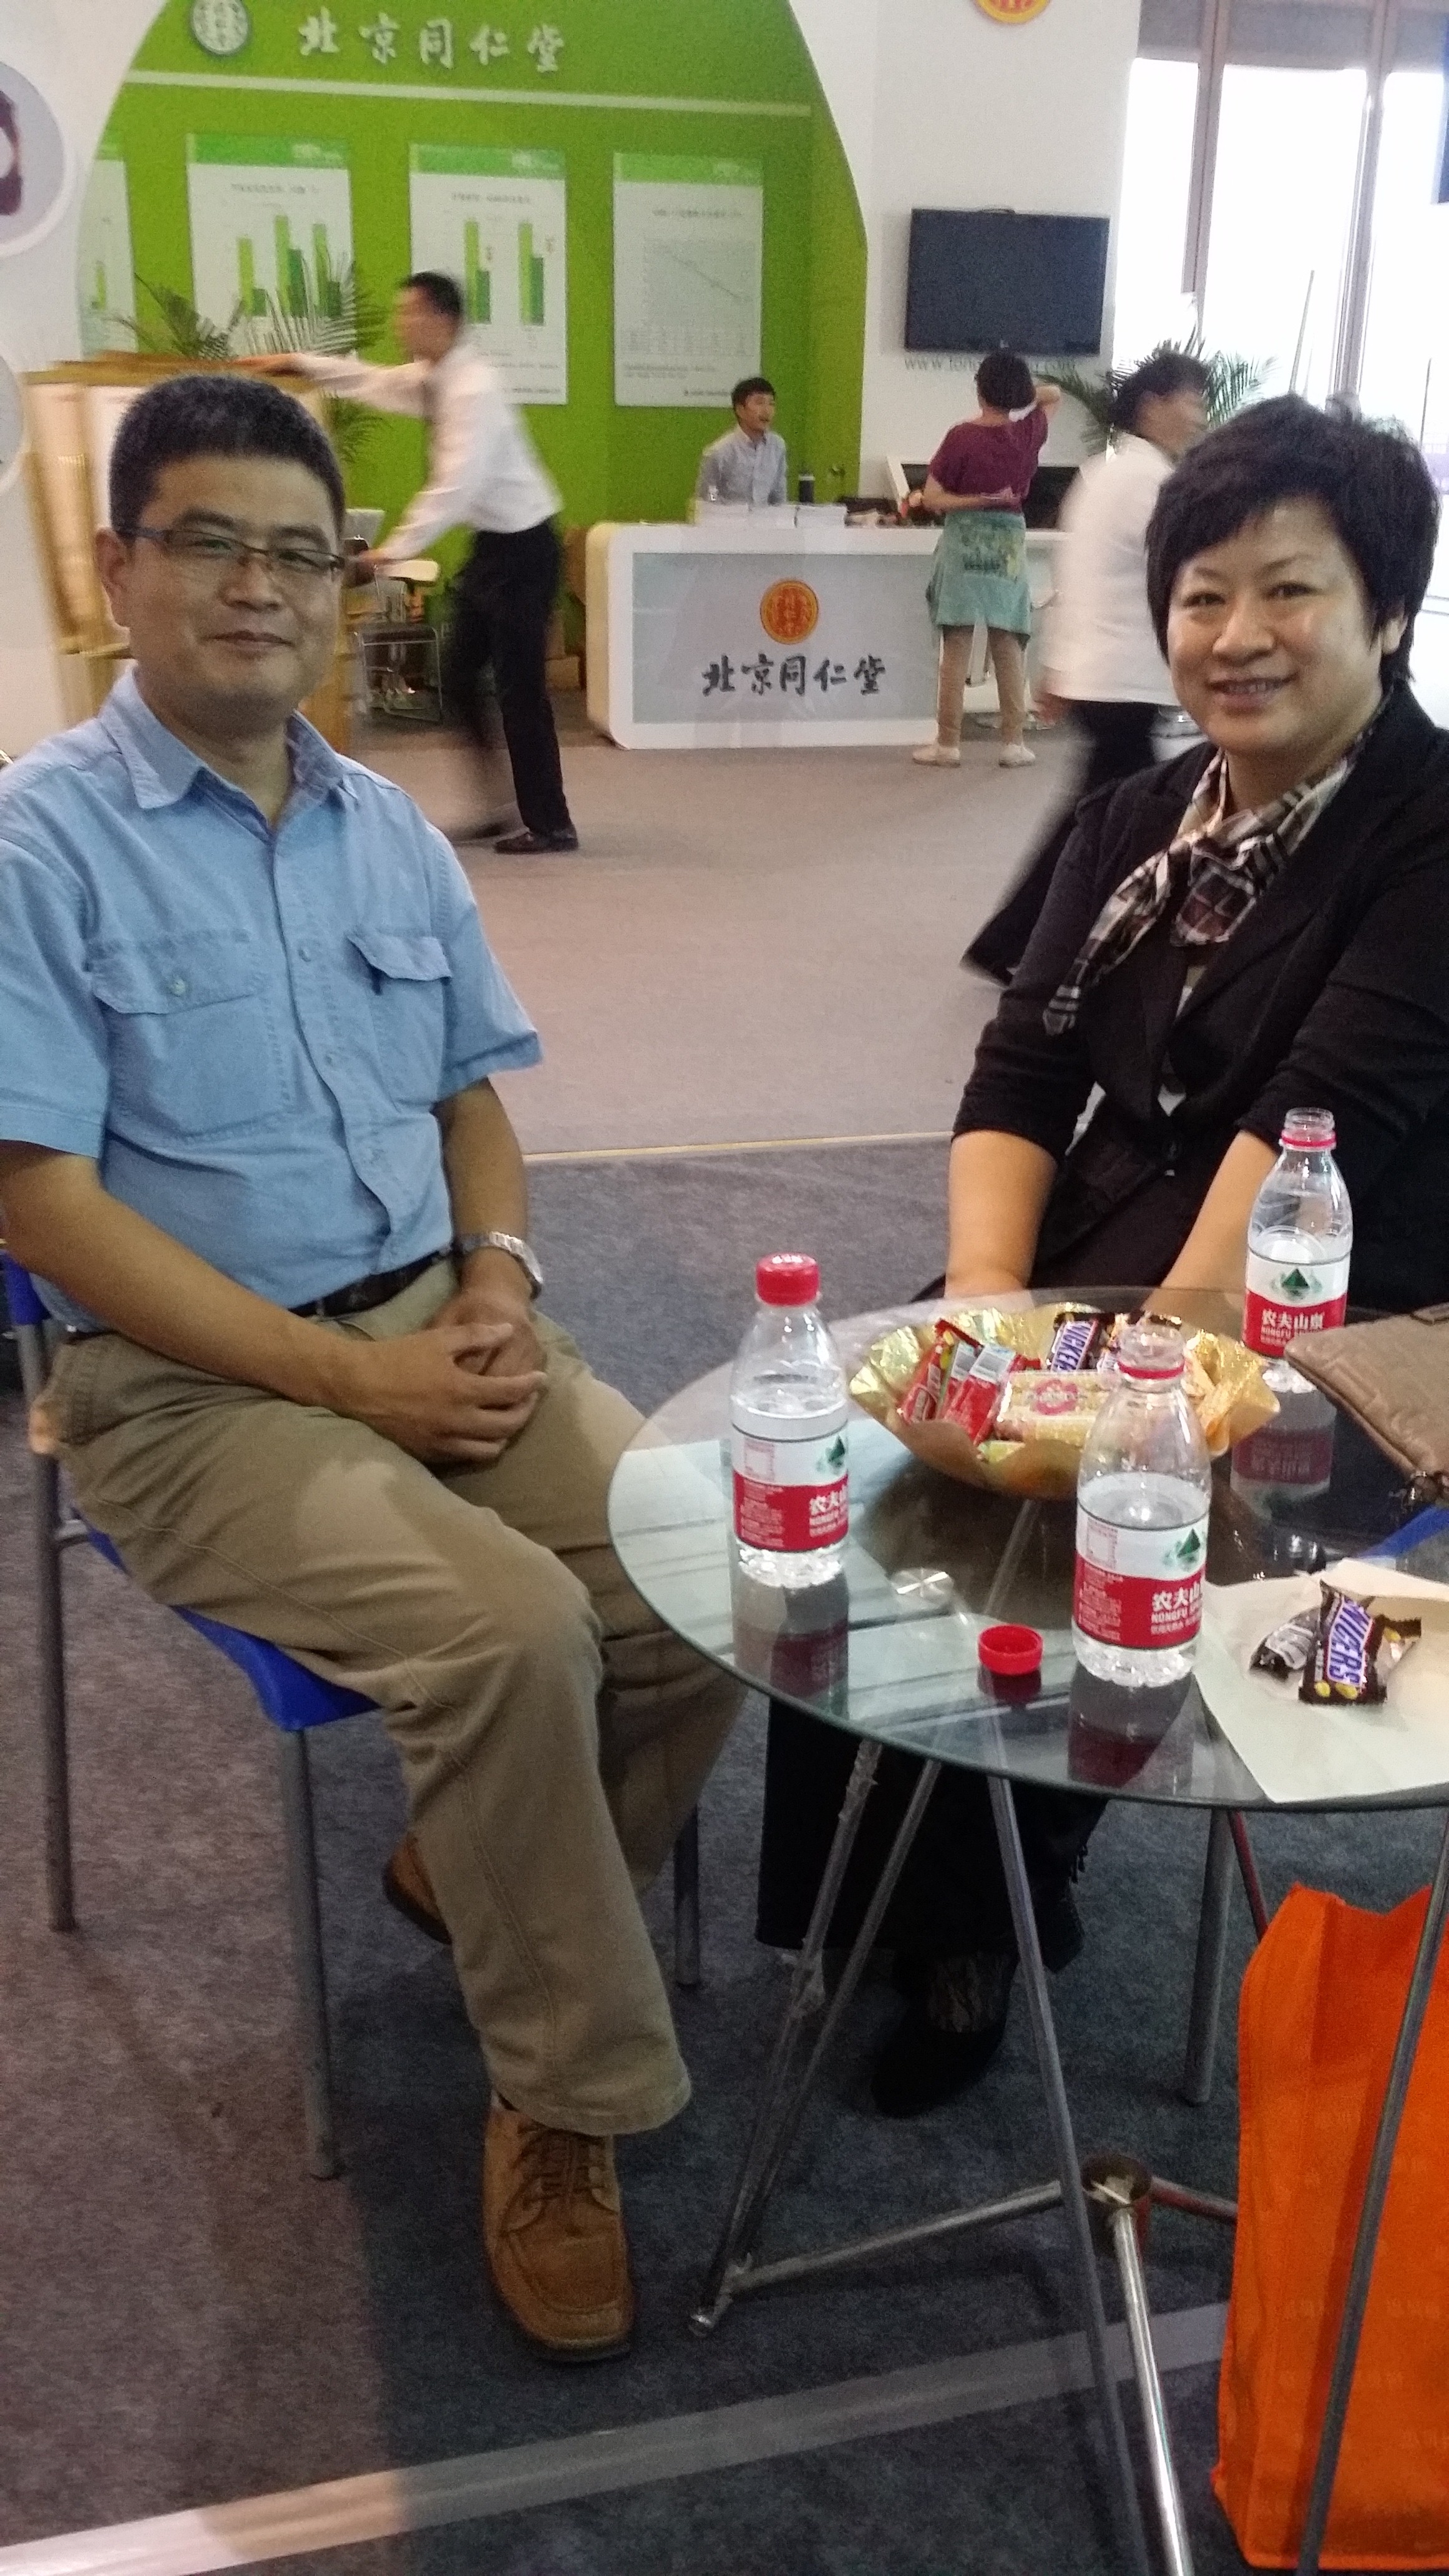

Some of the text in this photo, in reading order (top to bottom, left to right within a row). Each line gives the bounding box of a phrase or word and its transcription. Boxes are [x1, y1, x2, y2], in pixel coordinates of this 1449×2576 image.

[298, 6, 564, 73] 北京同仁堂
[701, 653, 886, 696] 北京同仁堂
